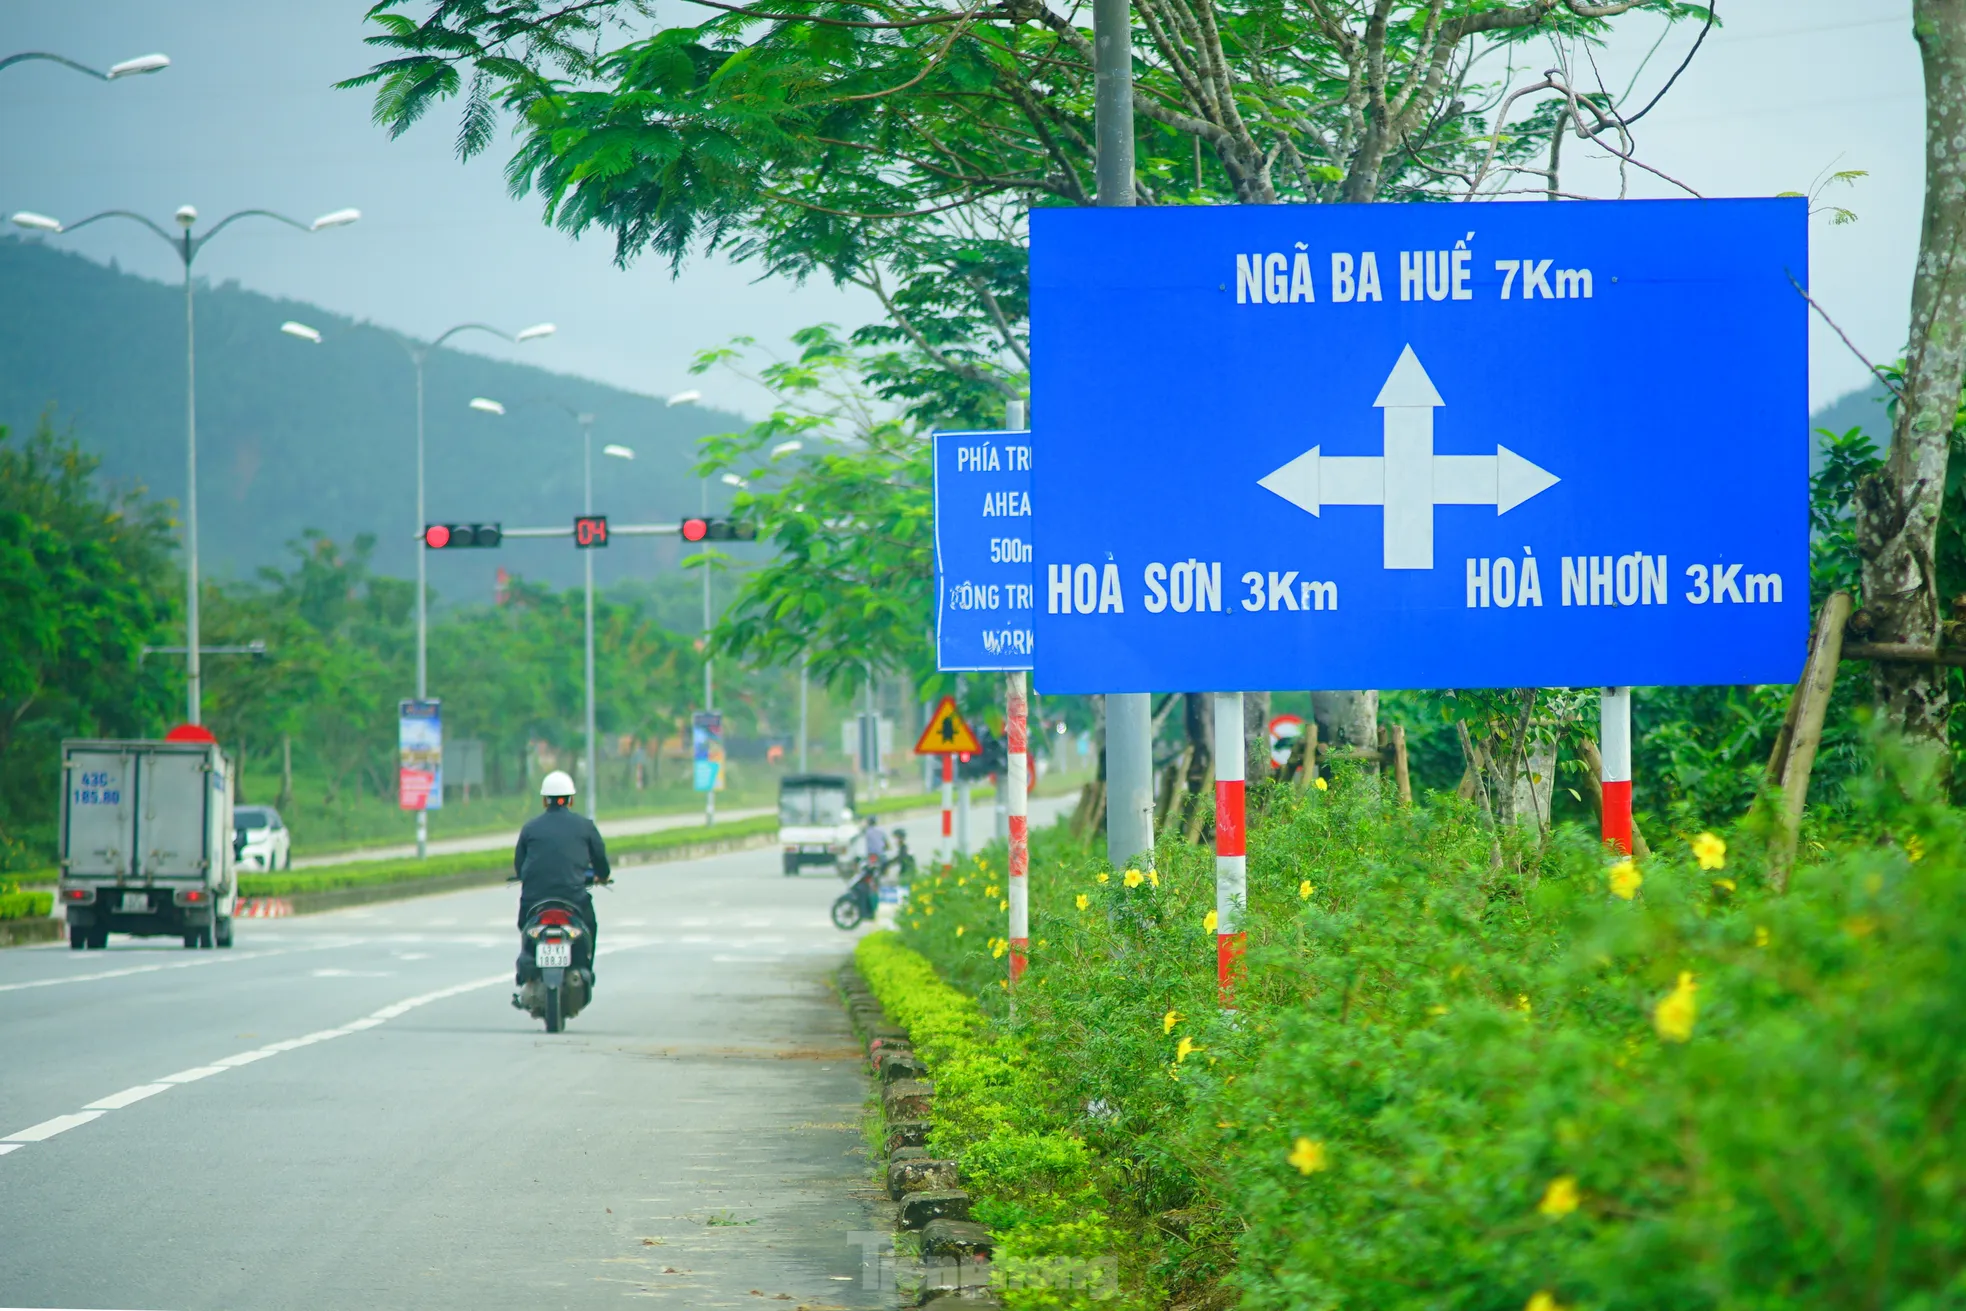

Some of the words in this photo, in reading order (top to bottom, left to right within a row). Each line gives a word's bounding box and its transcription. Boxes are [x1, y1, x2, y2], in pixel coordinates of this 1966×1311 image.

[1236, 241, 1315, 304] NGÃ
[1332, 251, 1382, 302] BA
[1399, 231, 1475, 301] HUẾ
[1495, 259, 1593, 300] 7Km
[957, 441, 1001, 472] PHÍA
[577, 518, 606, 545] 04
[1048, 551, 1124, 614] HOÀ
[1144, 558, 1221, 614] SƠN
[1241, 571, 1338, 612] 3Km
[1466, 545, 1543, 608] HOÀ
[1561, 551, 1667, 606] NHƠN
[1685, 563, 1782, 604] 3Km
